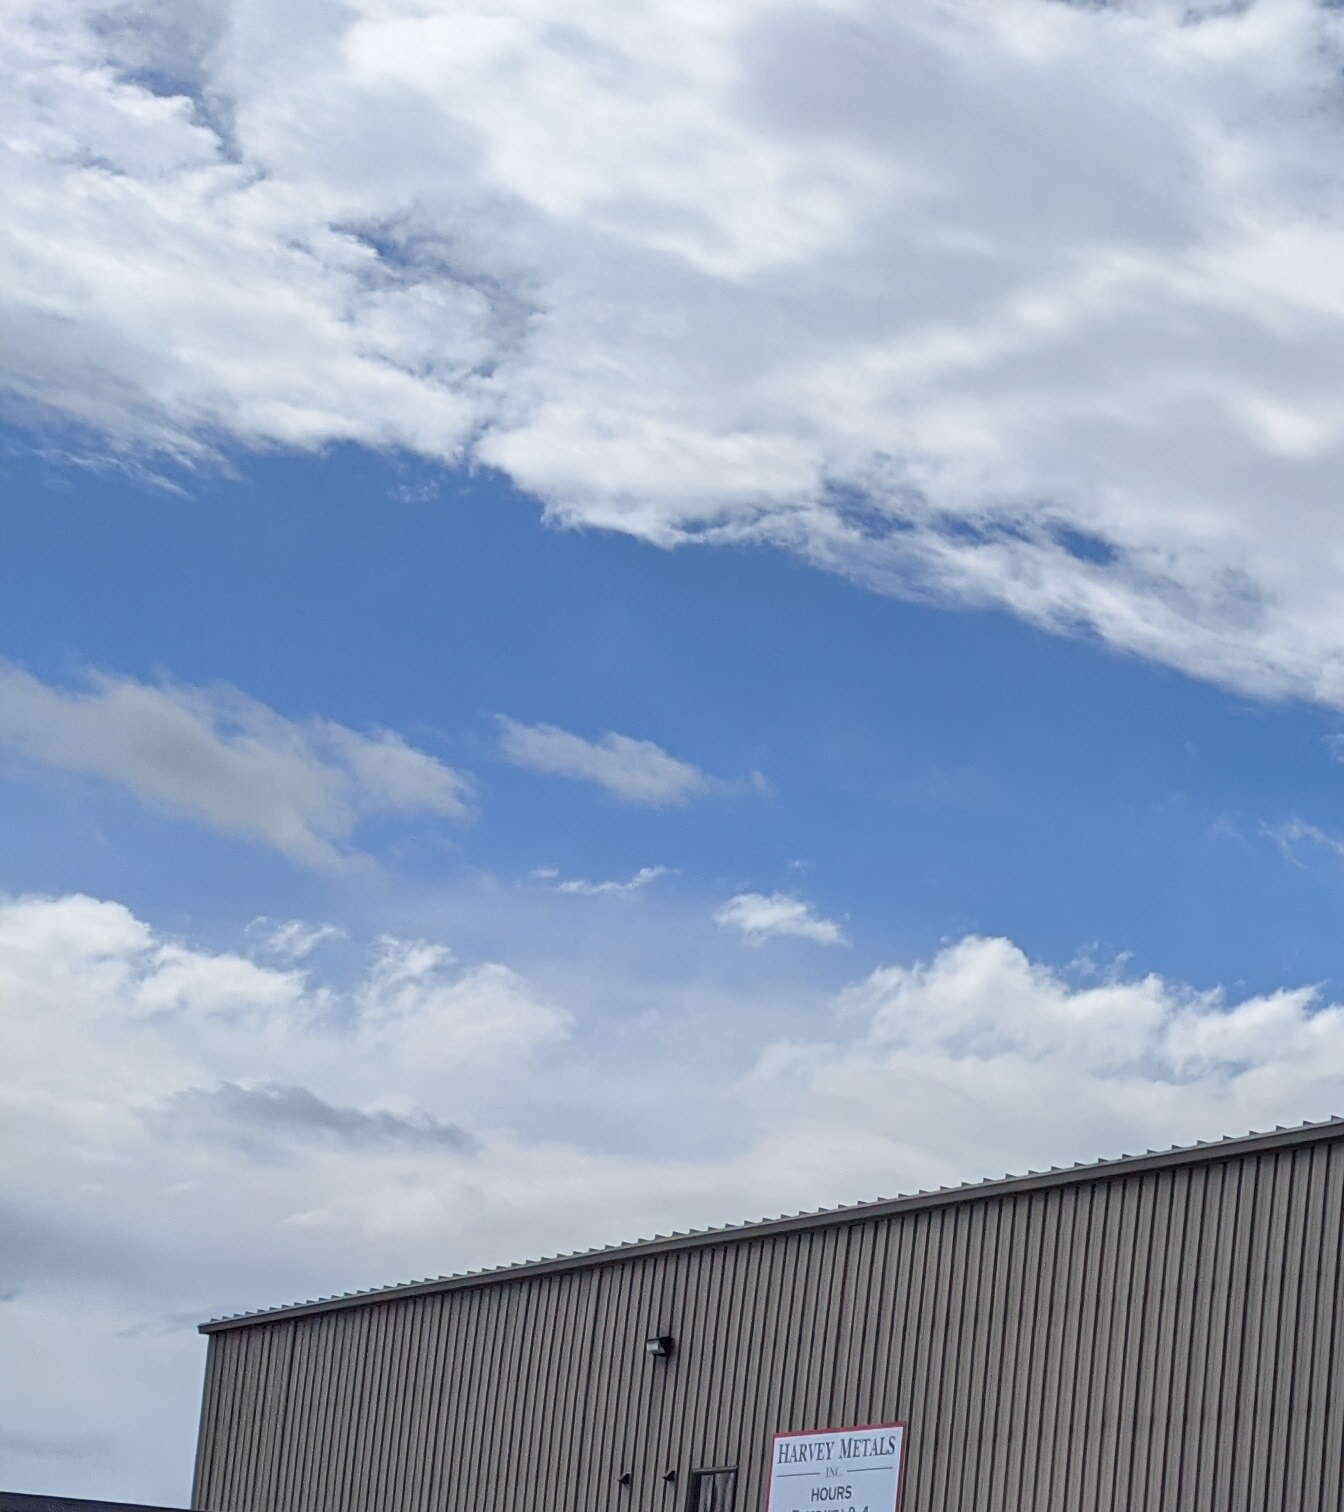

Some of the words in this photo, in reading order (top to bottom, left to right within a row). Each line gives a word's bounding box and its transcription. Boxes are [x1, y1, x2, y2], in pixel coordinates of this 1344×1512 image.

[777, 1441, 834, 1465] HARVEY
[839, 1435, 896, 1460] METALS
[811, 1485, 853, 1502] HOURS
